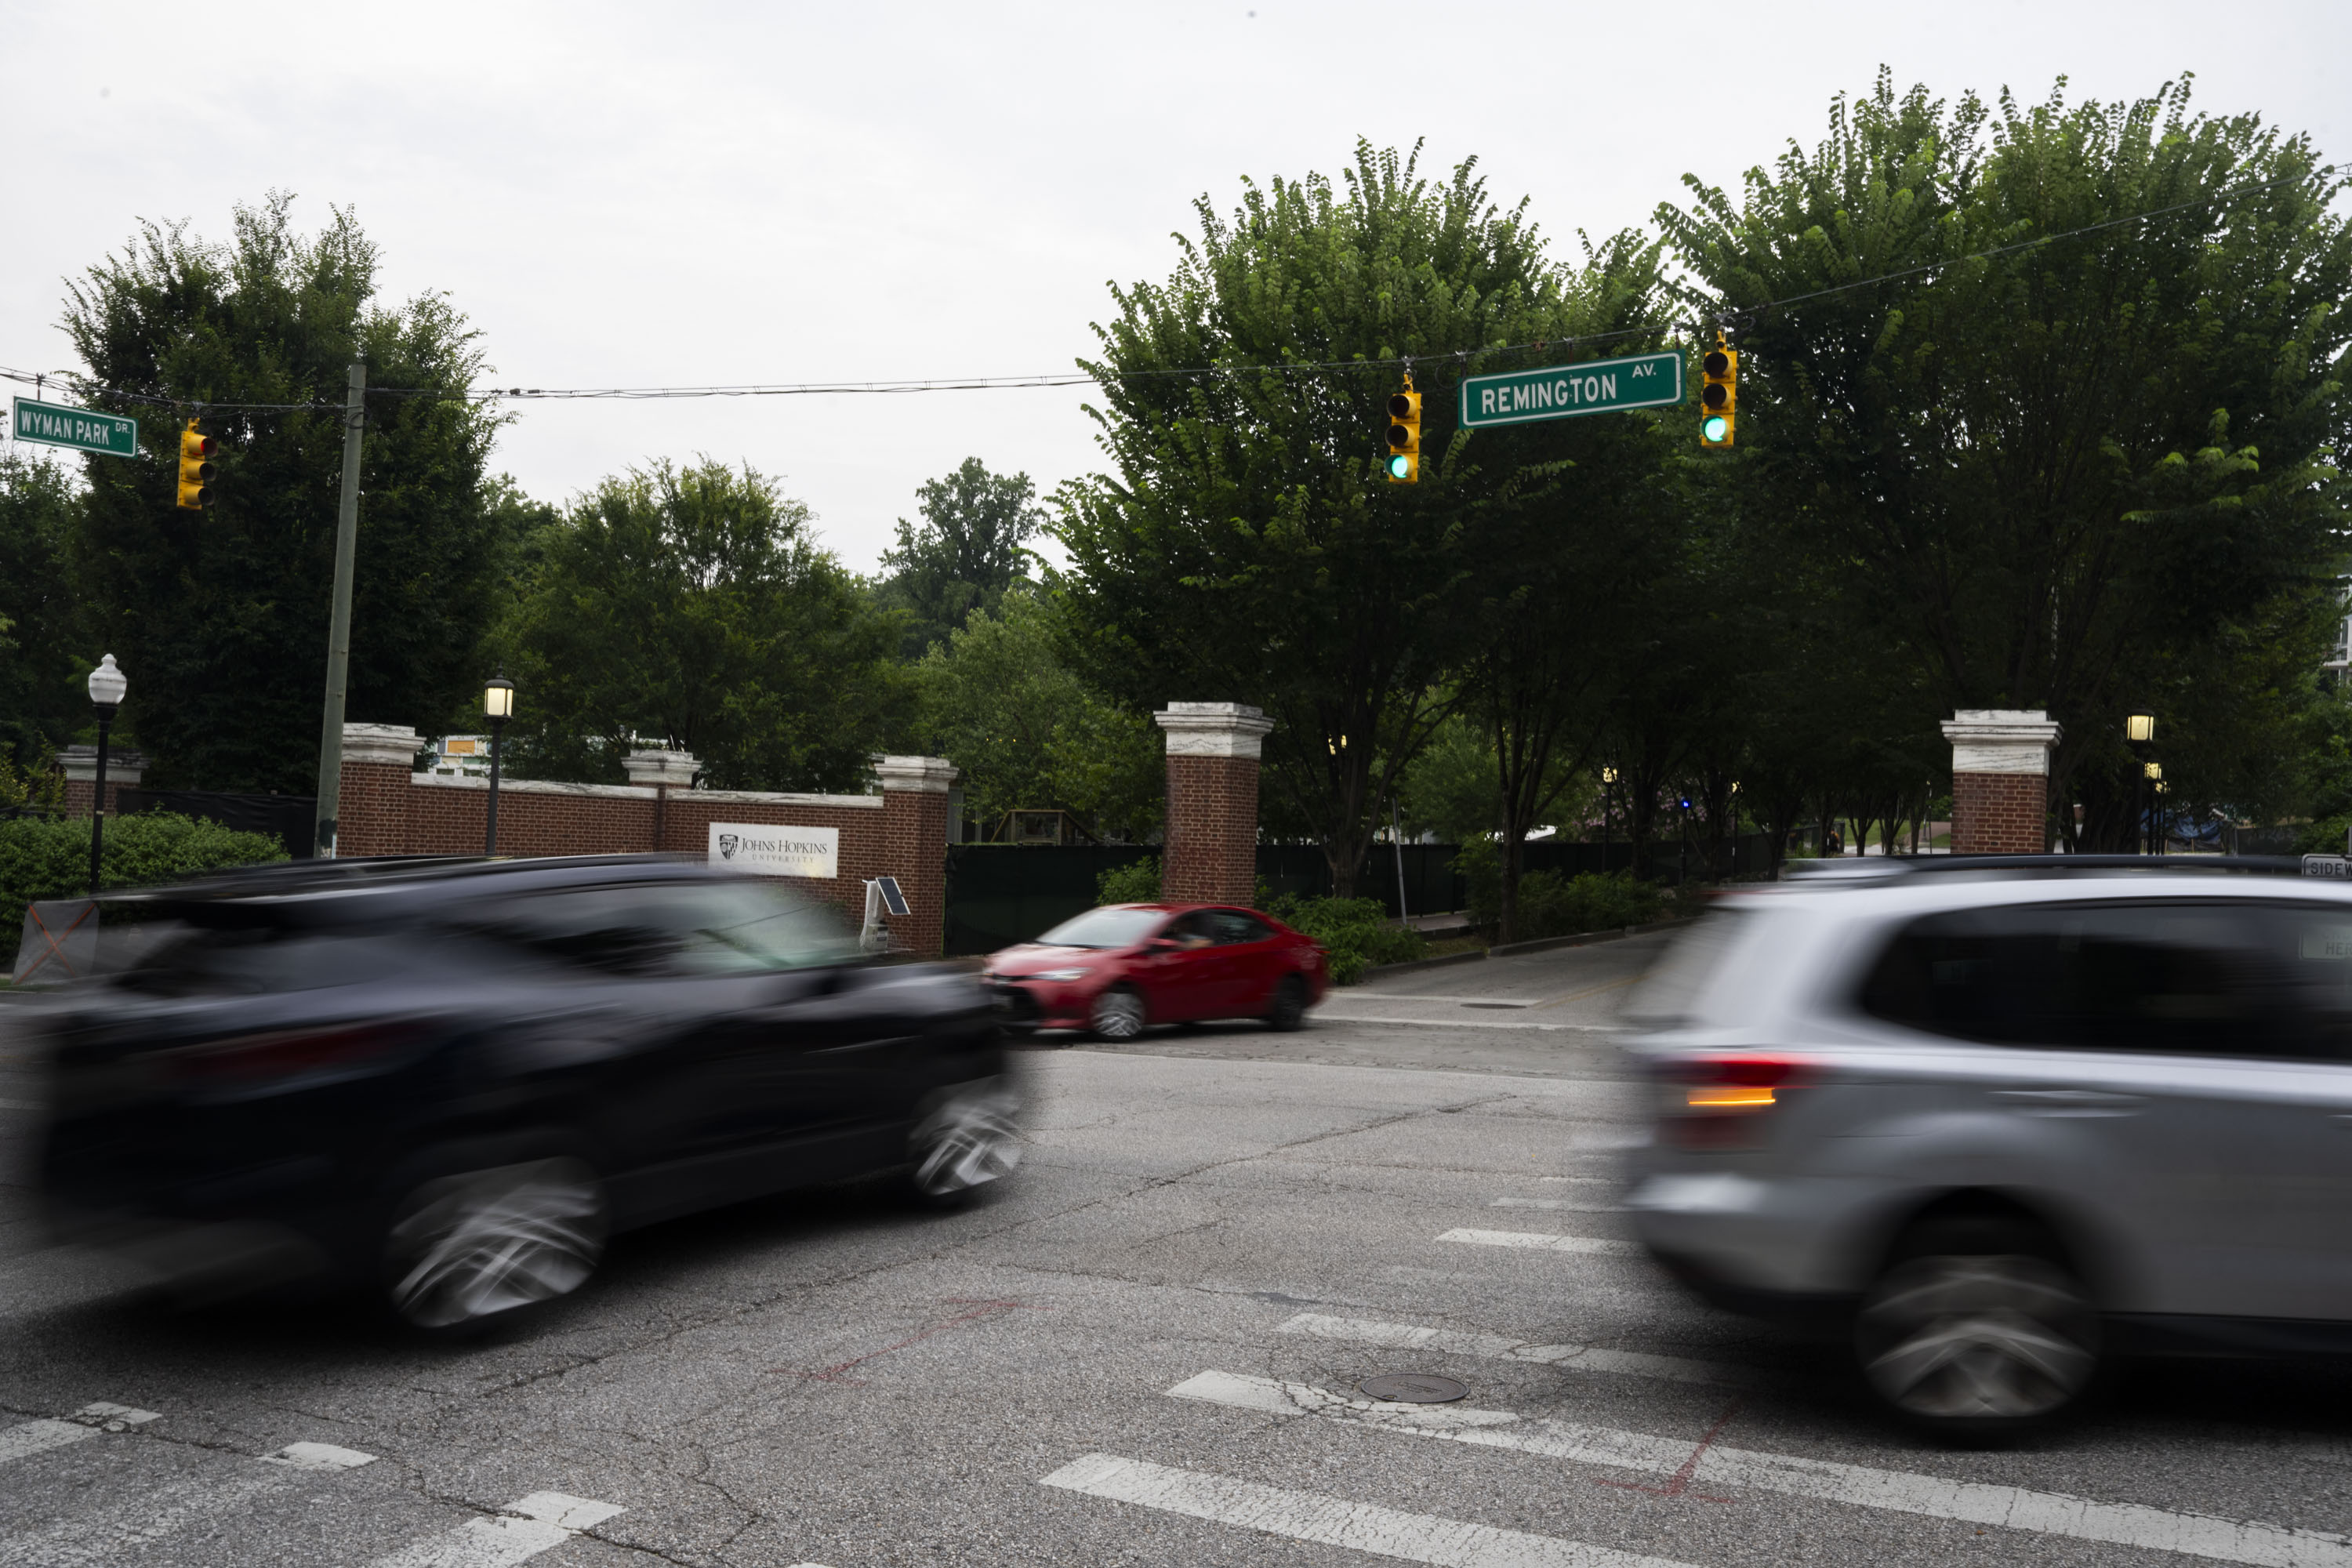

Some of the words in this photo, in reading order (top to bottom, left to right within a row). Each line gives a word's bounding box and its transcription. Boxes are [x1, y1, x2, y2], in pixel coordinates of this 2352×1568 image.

[1482, 373, 1617, 414] REMINGTON
[1632, 363, 1657, 378] AV.
[21, 411, 72, 439] WYMAN
[76, 420, 110, 445] PARK
[741, 838, 775, 853] JOHNS
[779, 840, 827, 855] HOPKINS
[752, 854, 814, 863] UNIVERSITY
